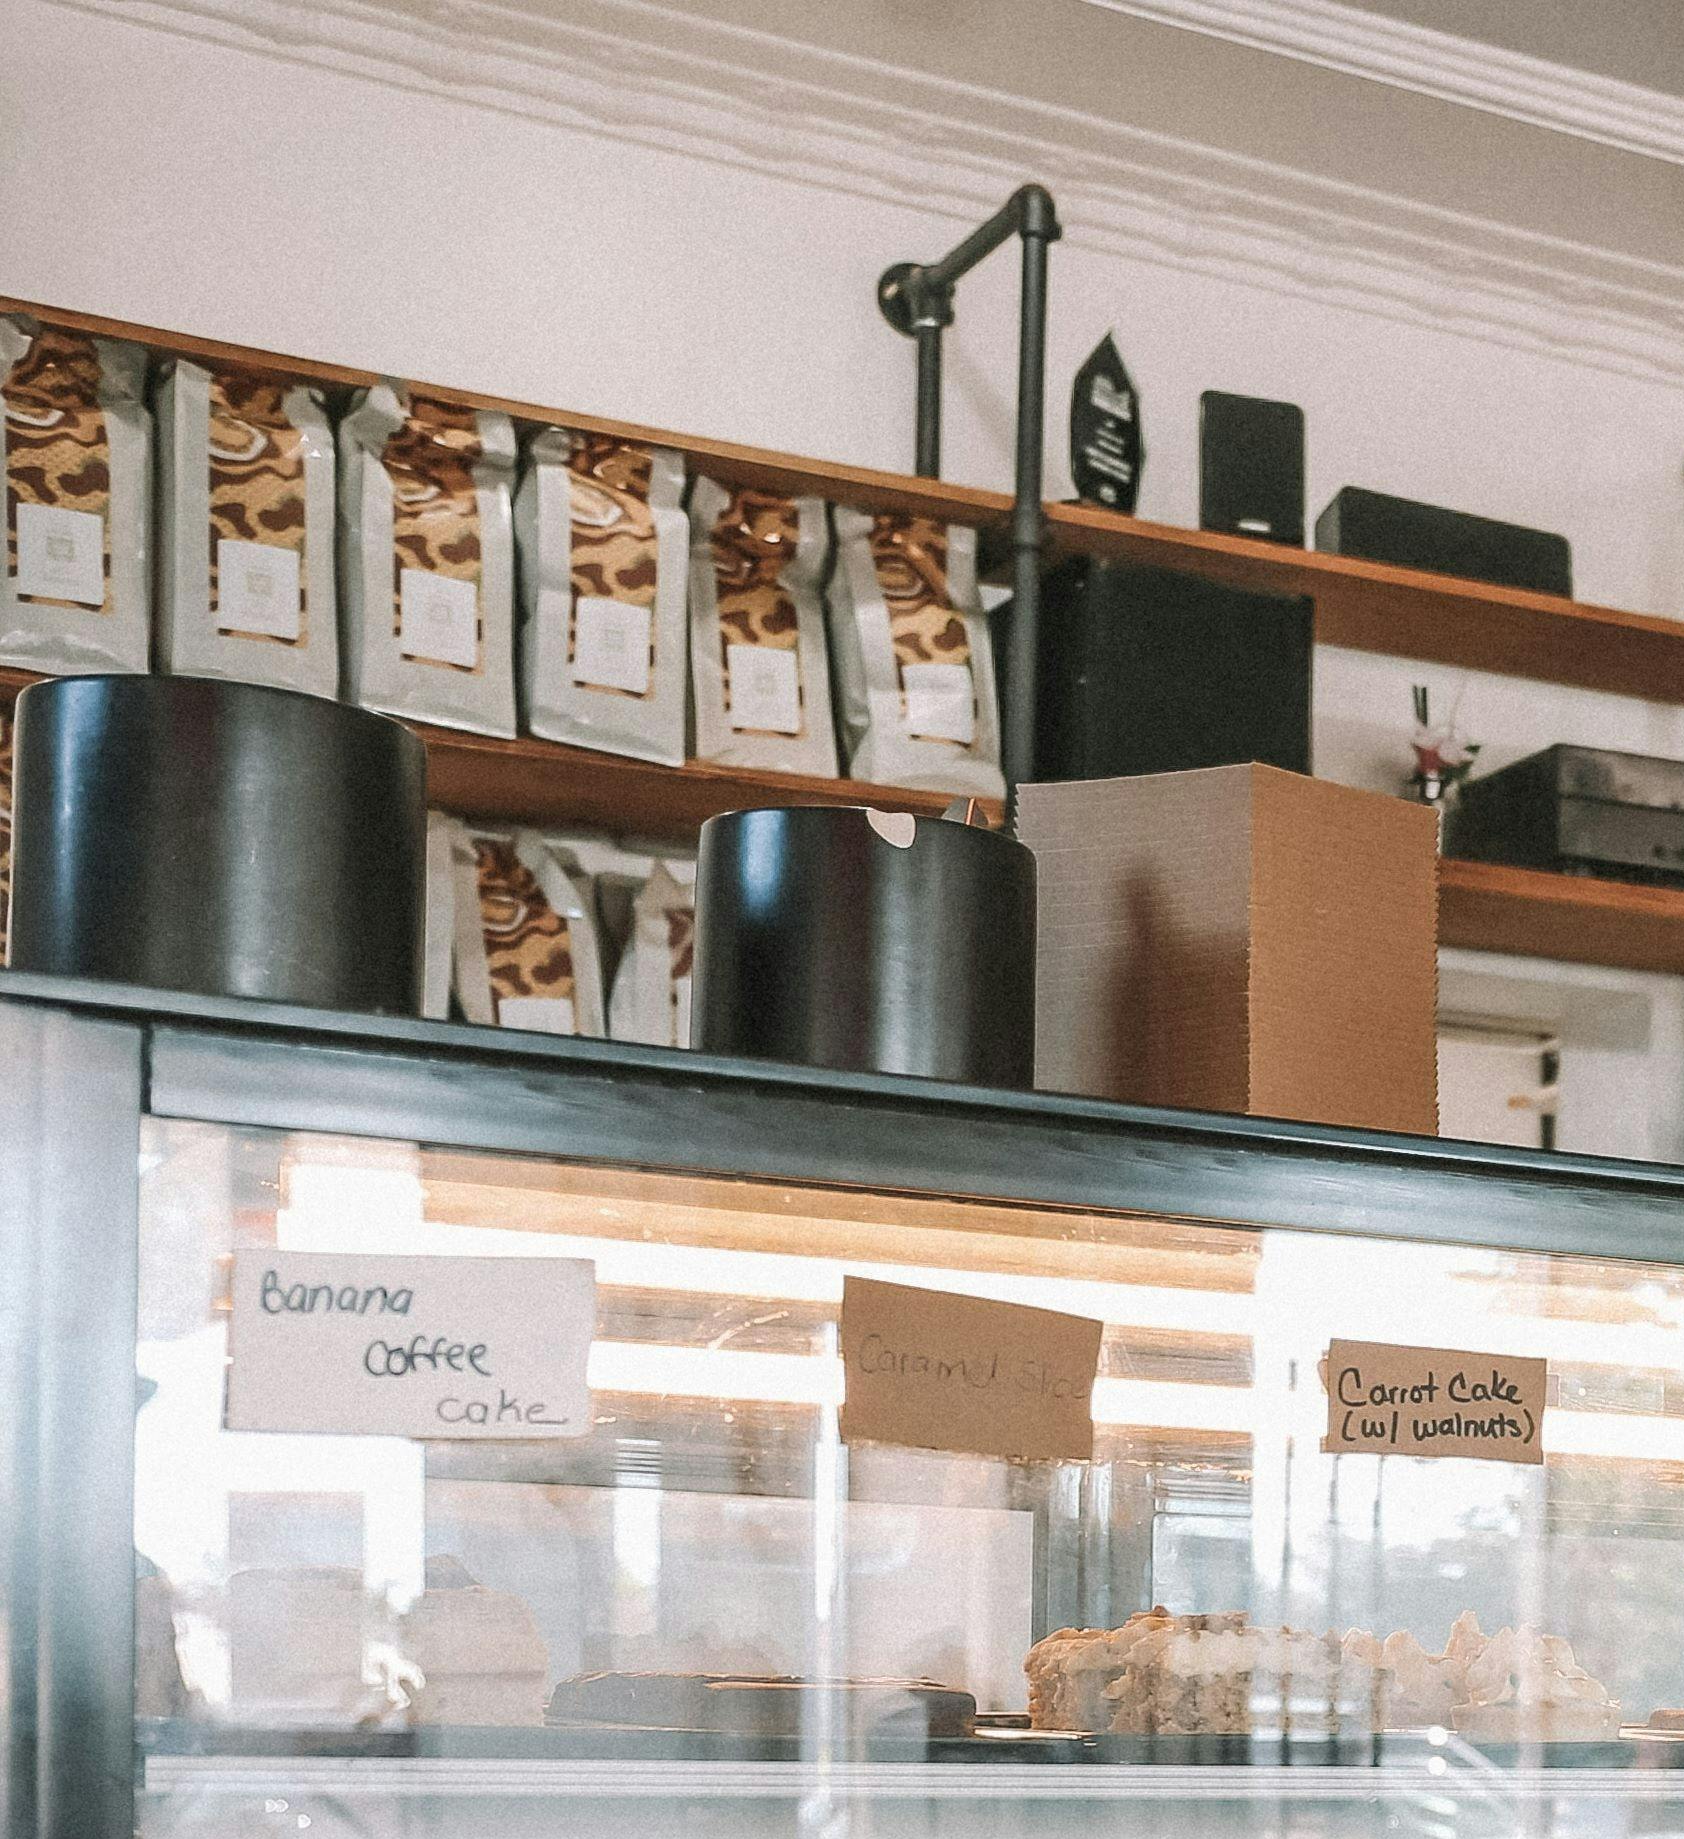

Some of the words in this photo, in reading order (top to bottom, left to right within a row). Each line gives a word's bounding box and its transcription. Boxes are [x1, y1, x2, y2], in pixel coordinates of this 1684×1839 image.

[259, 1271, 413, 1316] Banana
[1338, 1367, 1439, 1407] Carrot
[1449, 1369, 1522, 1404] Cake
[1412, 1408, 1535, 1444] walnuts)
